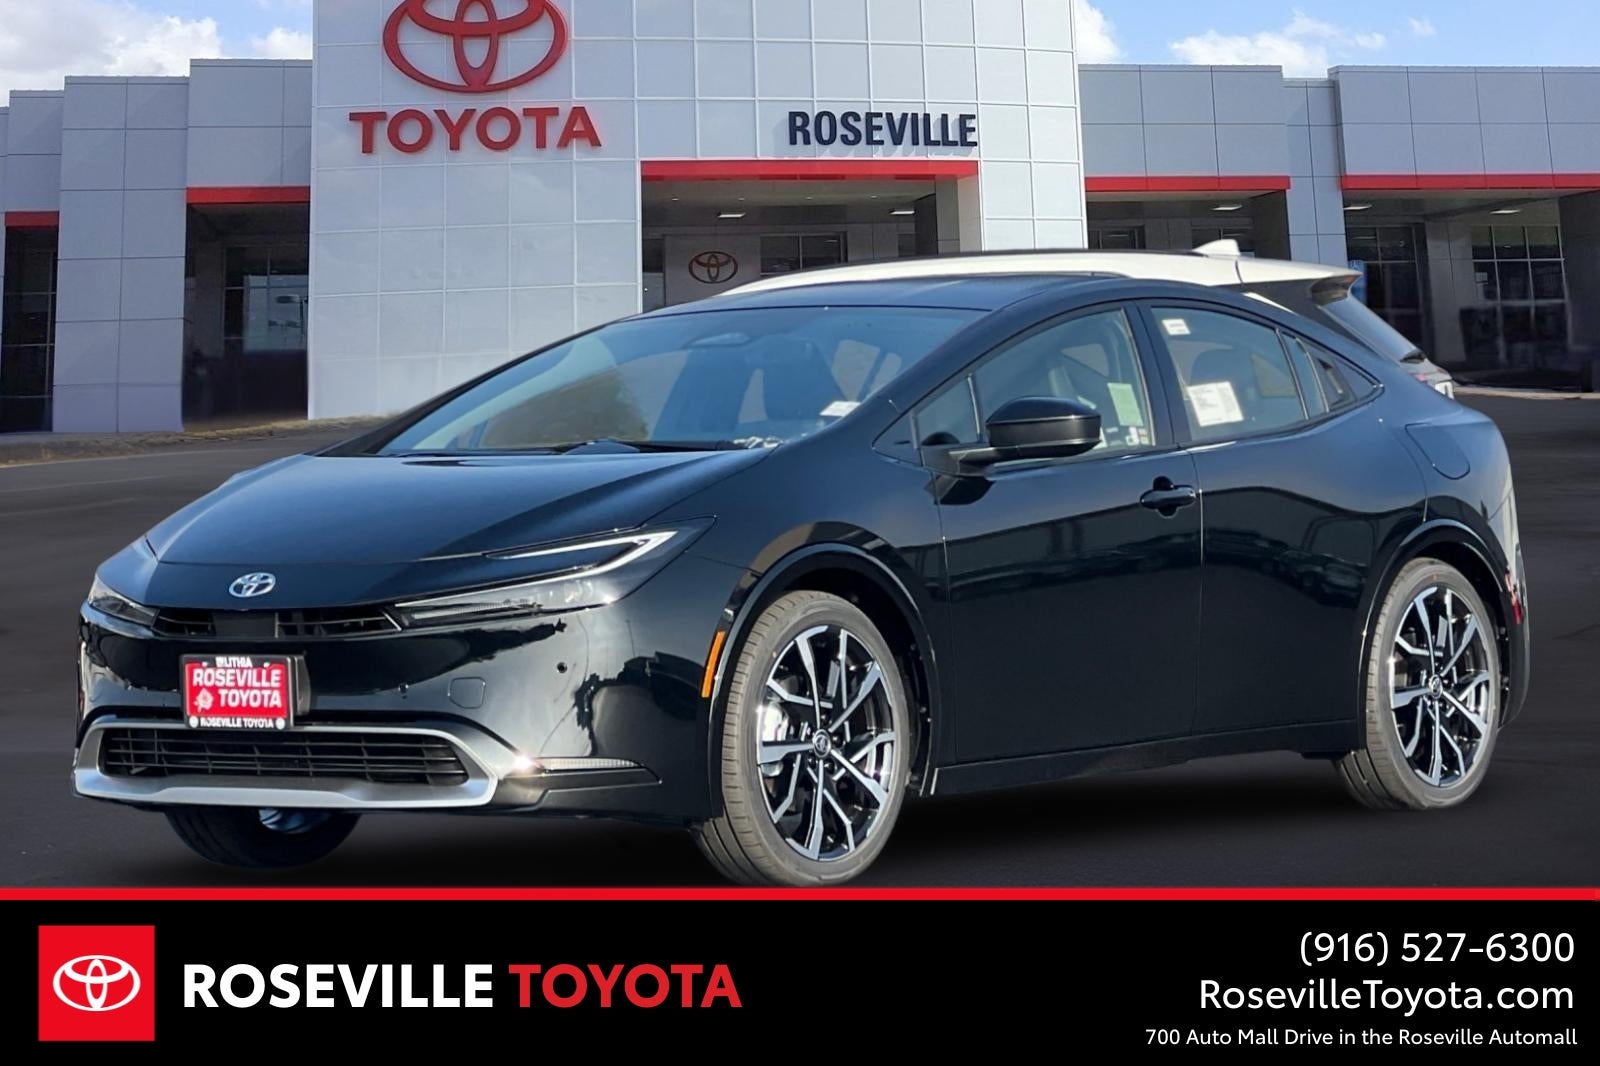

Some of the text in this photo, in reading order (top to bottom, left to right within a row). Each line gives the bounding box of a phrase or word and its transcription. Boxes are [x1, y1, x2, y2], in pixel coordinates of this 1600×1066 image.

[349, 106, 602, 154] TOYOTA
[788, 110, 978, 147] ROSEVILLE
[192, 668, 282, 688] ROSEVILLE
[218, 689, 283, 708] TOYOTA
